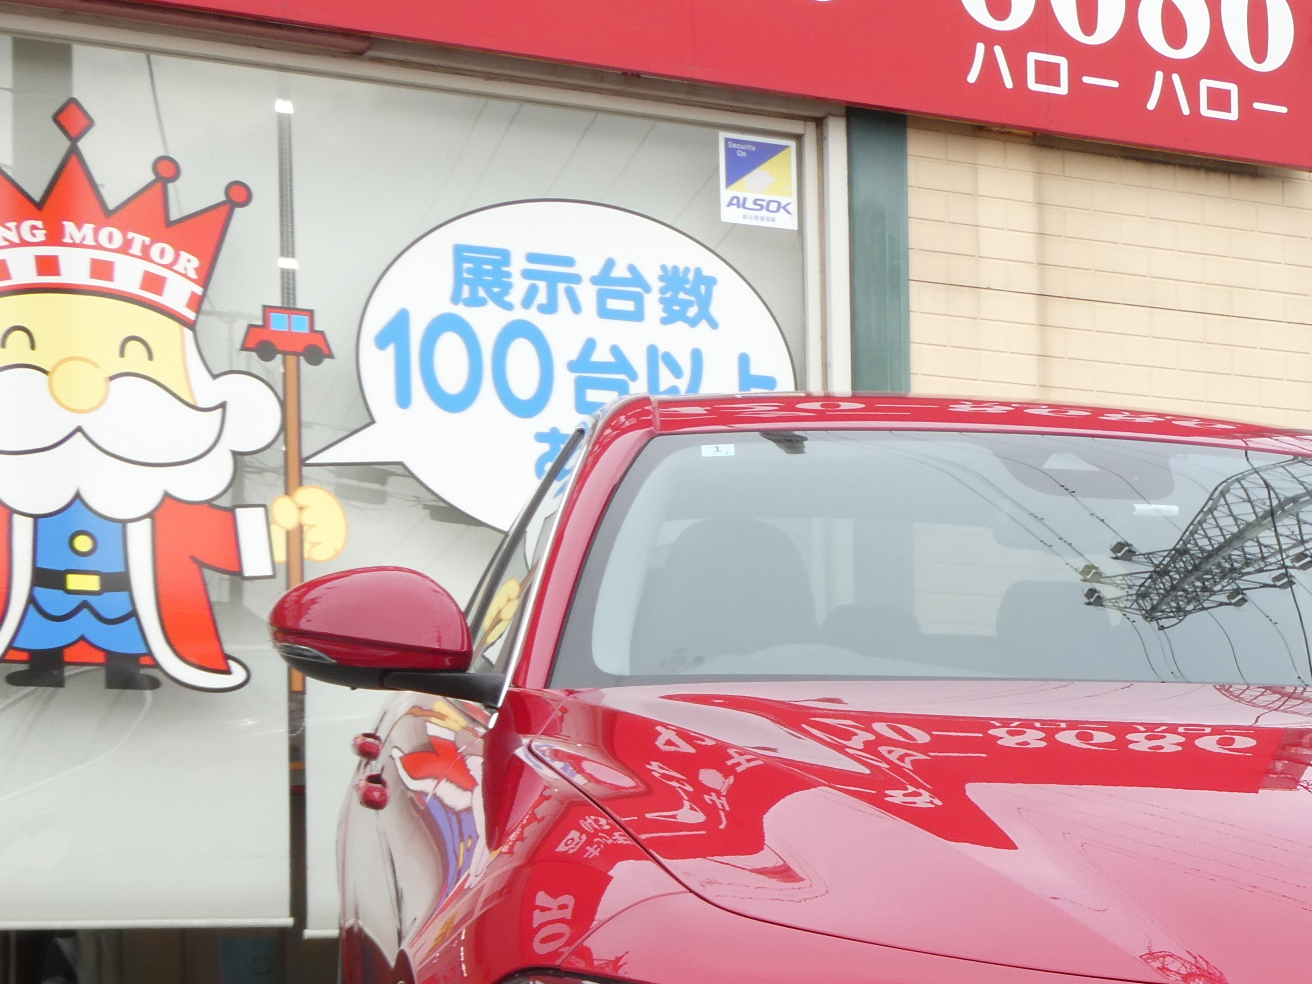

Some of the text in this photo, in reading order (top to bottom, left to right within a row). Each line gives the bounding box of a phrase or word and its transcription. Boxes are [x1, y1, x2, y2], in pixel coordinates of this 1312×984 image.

[967, 42, 1289, 121] ハロー ハロー
[727, 141, 756, 151] Security
[726, 195, 793, 216] ALSOK
[61, 220, 201, 279] MOTOR
[449, 242, 720, 331] 展示台数
